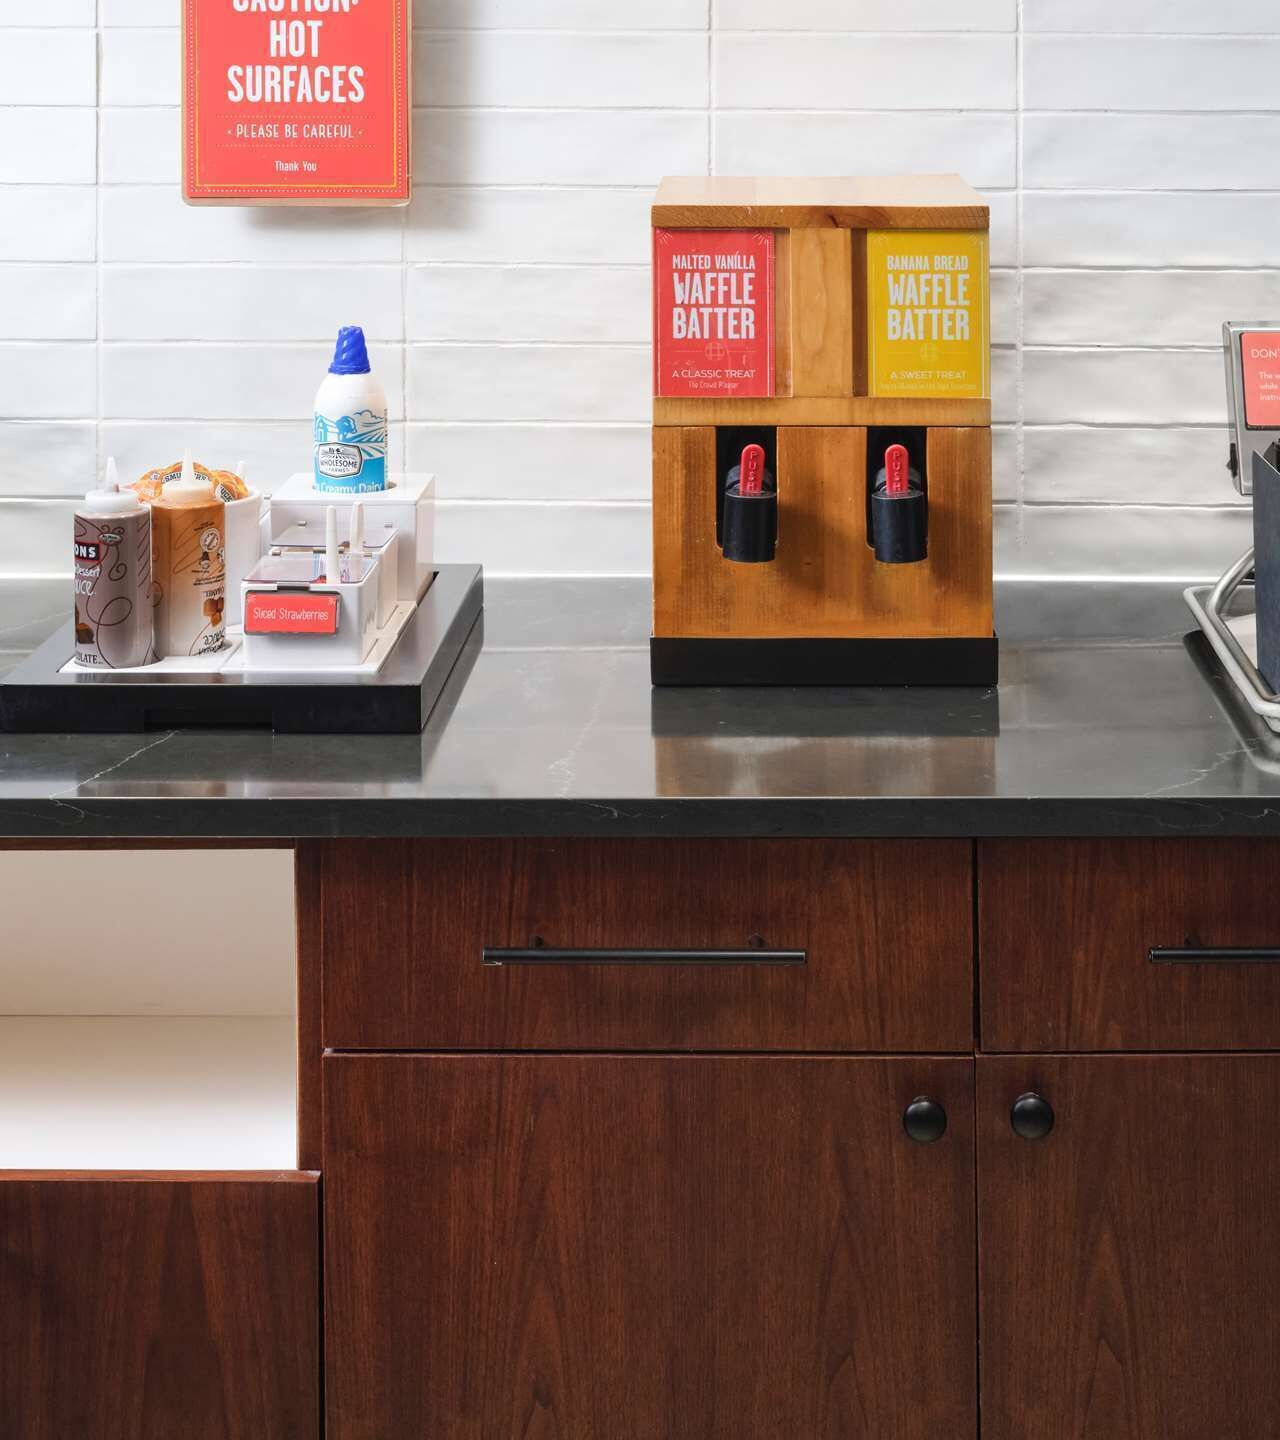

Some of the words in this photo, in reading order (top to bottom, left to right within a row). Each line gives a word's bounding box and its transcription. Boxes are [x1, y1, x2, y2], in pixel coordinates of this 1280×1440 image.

[269, 20, 323, 57] HOT
[227, 65, 365, 103] SURFACES
[236, 123, 279, 138] PLEASE
[285, 123, 299, 138] BE
[303, 123, 354, 138] CAREFUL
[274, 160, 299, 172] Thank
[303, 160, 317, 172] You
[672, 254, 711, 270] MALTED
[887, 255, 929, 270] BANANA
[934, 255, 969, 270] BREAD
[672, 272, 755, 305] WAFFLE
[887, 273, 970, 305] WAFFLE
[672, 307, 755, 339] BATTER
[887, 309, 970, 340] BATTER
[672, 369, 679, 378] A
[681, 369, 722, 378] CLASSIC
[724, 369, 755, 378] TREAT
[899, 370, 933, 380] SWEET
[935, 370, 967, 380] TREAT
[1259, 372, 1271, 380] The
[253, 607, 276, 620] Sliced
[279, 607, 328, 620] Strawberries
